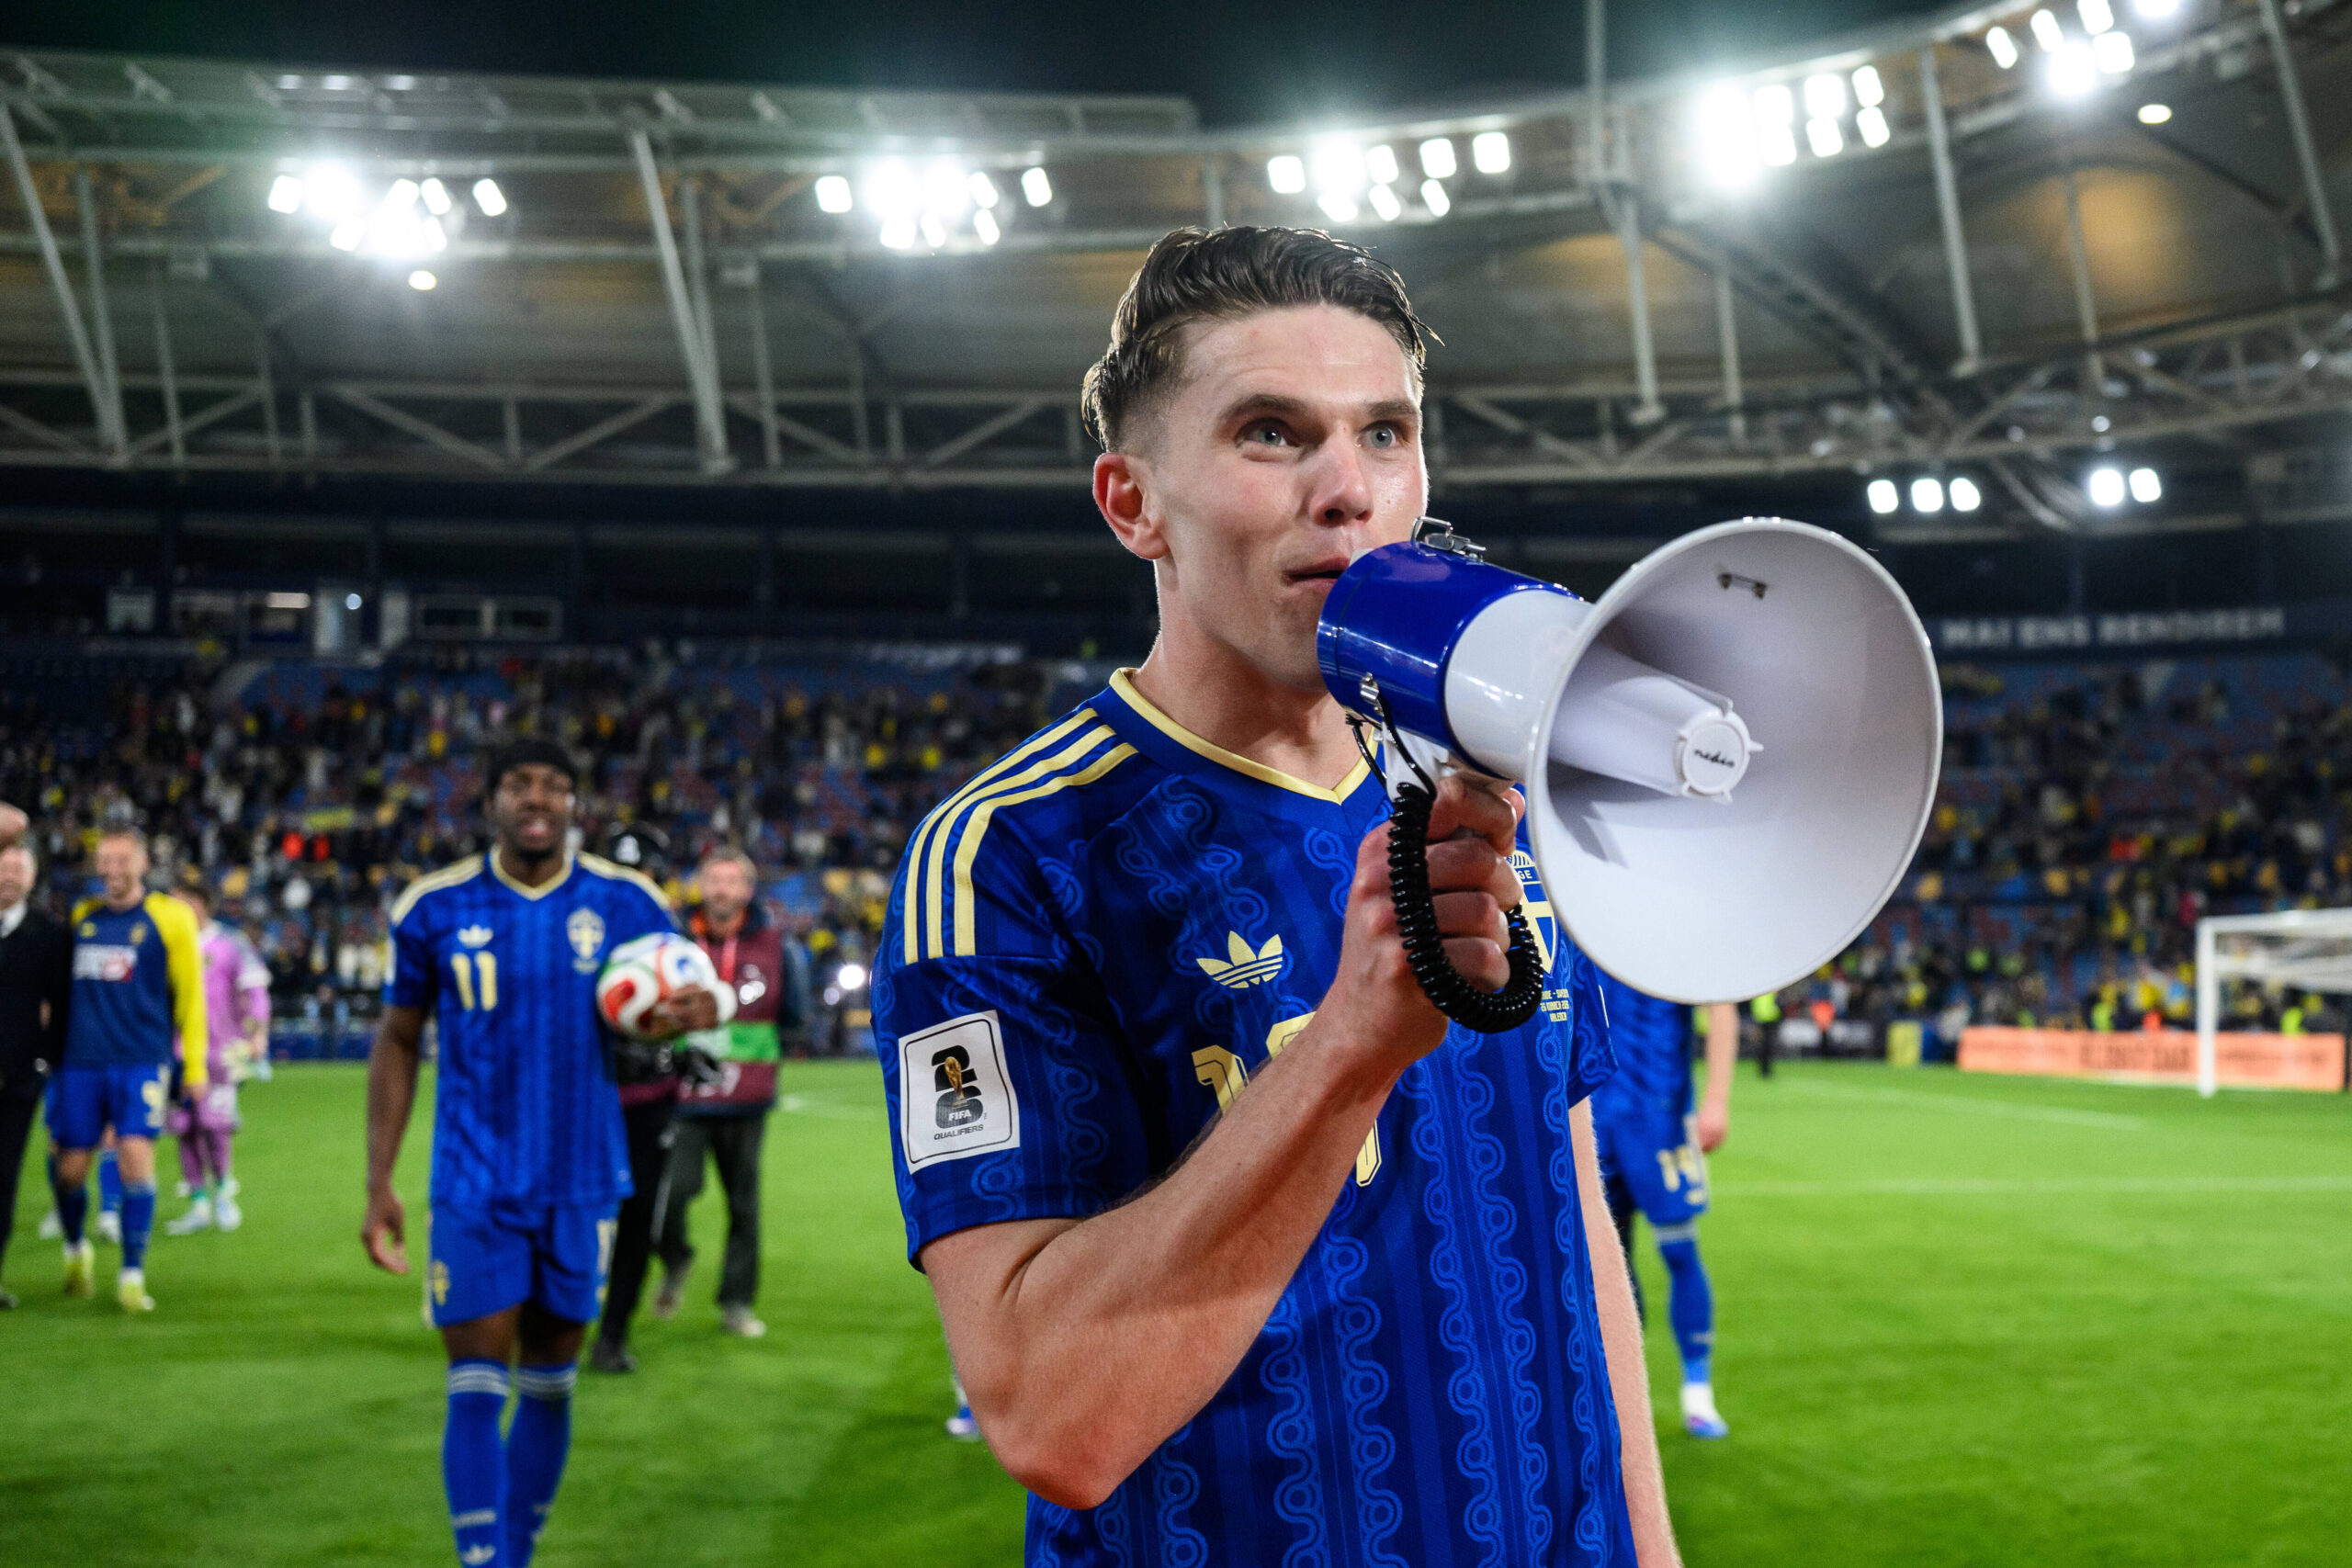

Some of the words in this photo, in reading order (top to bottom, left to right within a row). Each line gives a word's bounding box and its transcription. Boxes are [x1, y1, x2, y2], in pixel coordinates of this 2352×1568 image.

[1942, 618, 2011, 648] MAI
[2018, 617, 2090, 647] ENS
[2098, 608, 2284, 644] RENDIREM
[451, 952, 497, 1011] 11
[948, 1109, 971, 1122] FIFA
[933, 1124, 984, 1140] QUALIFIERS
